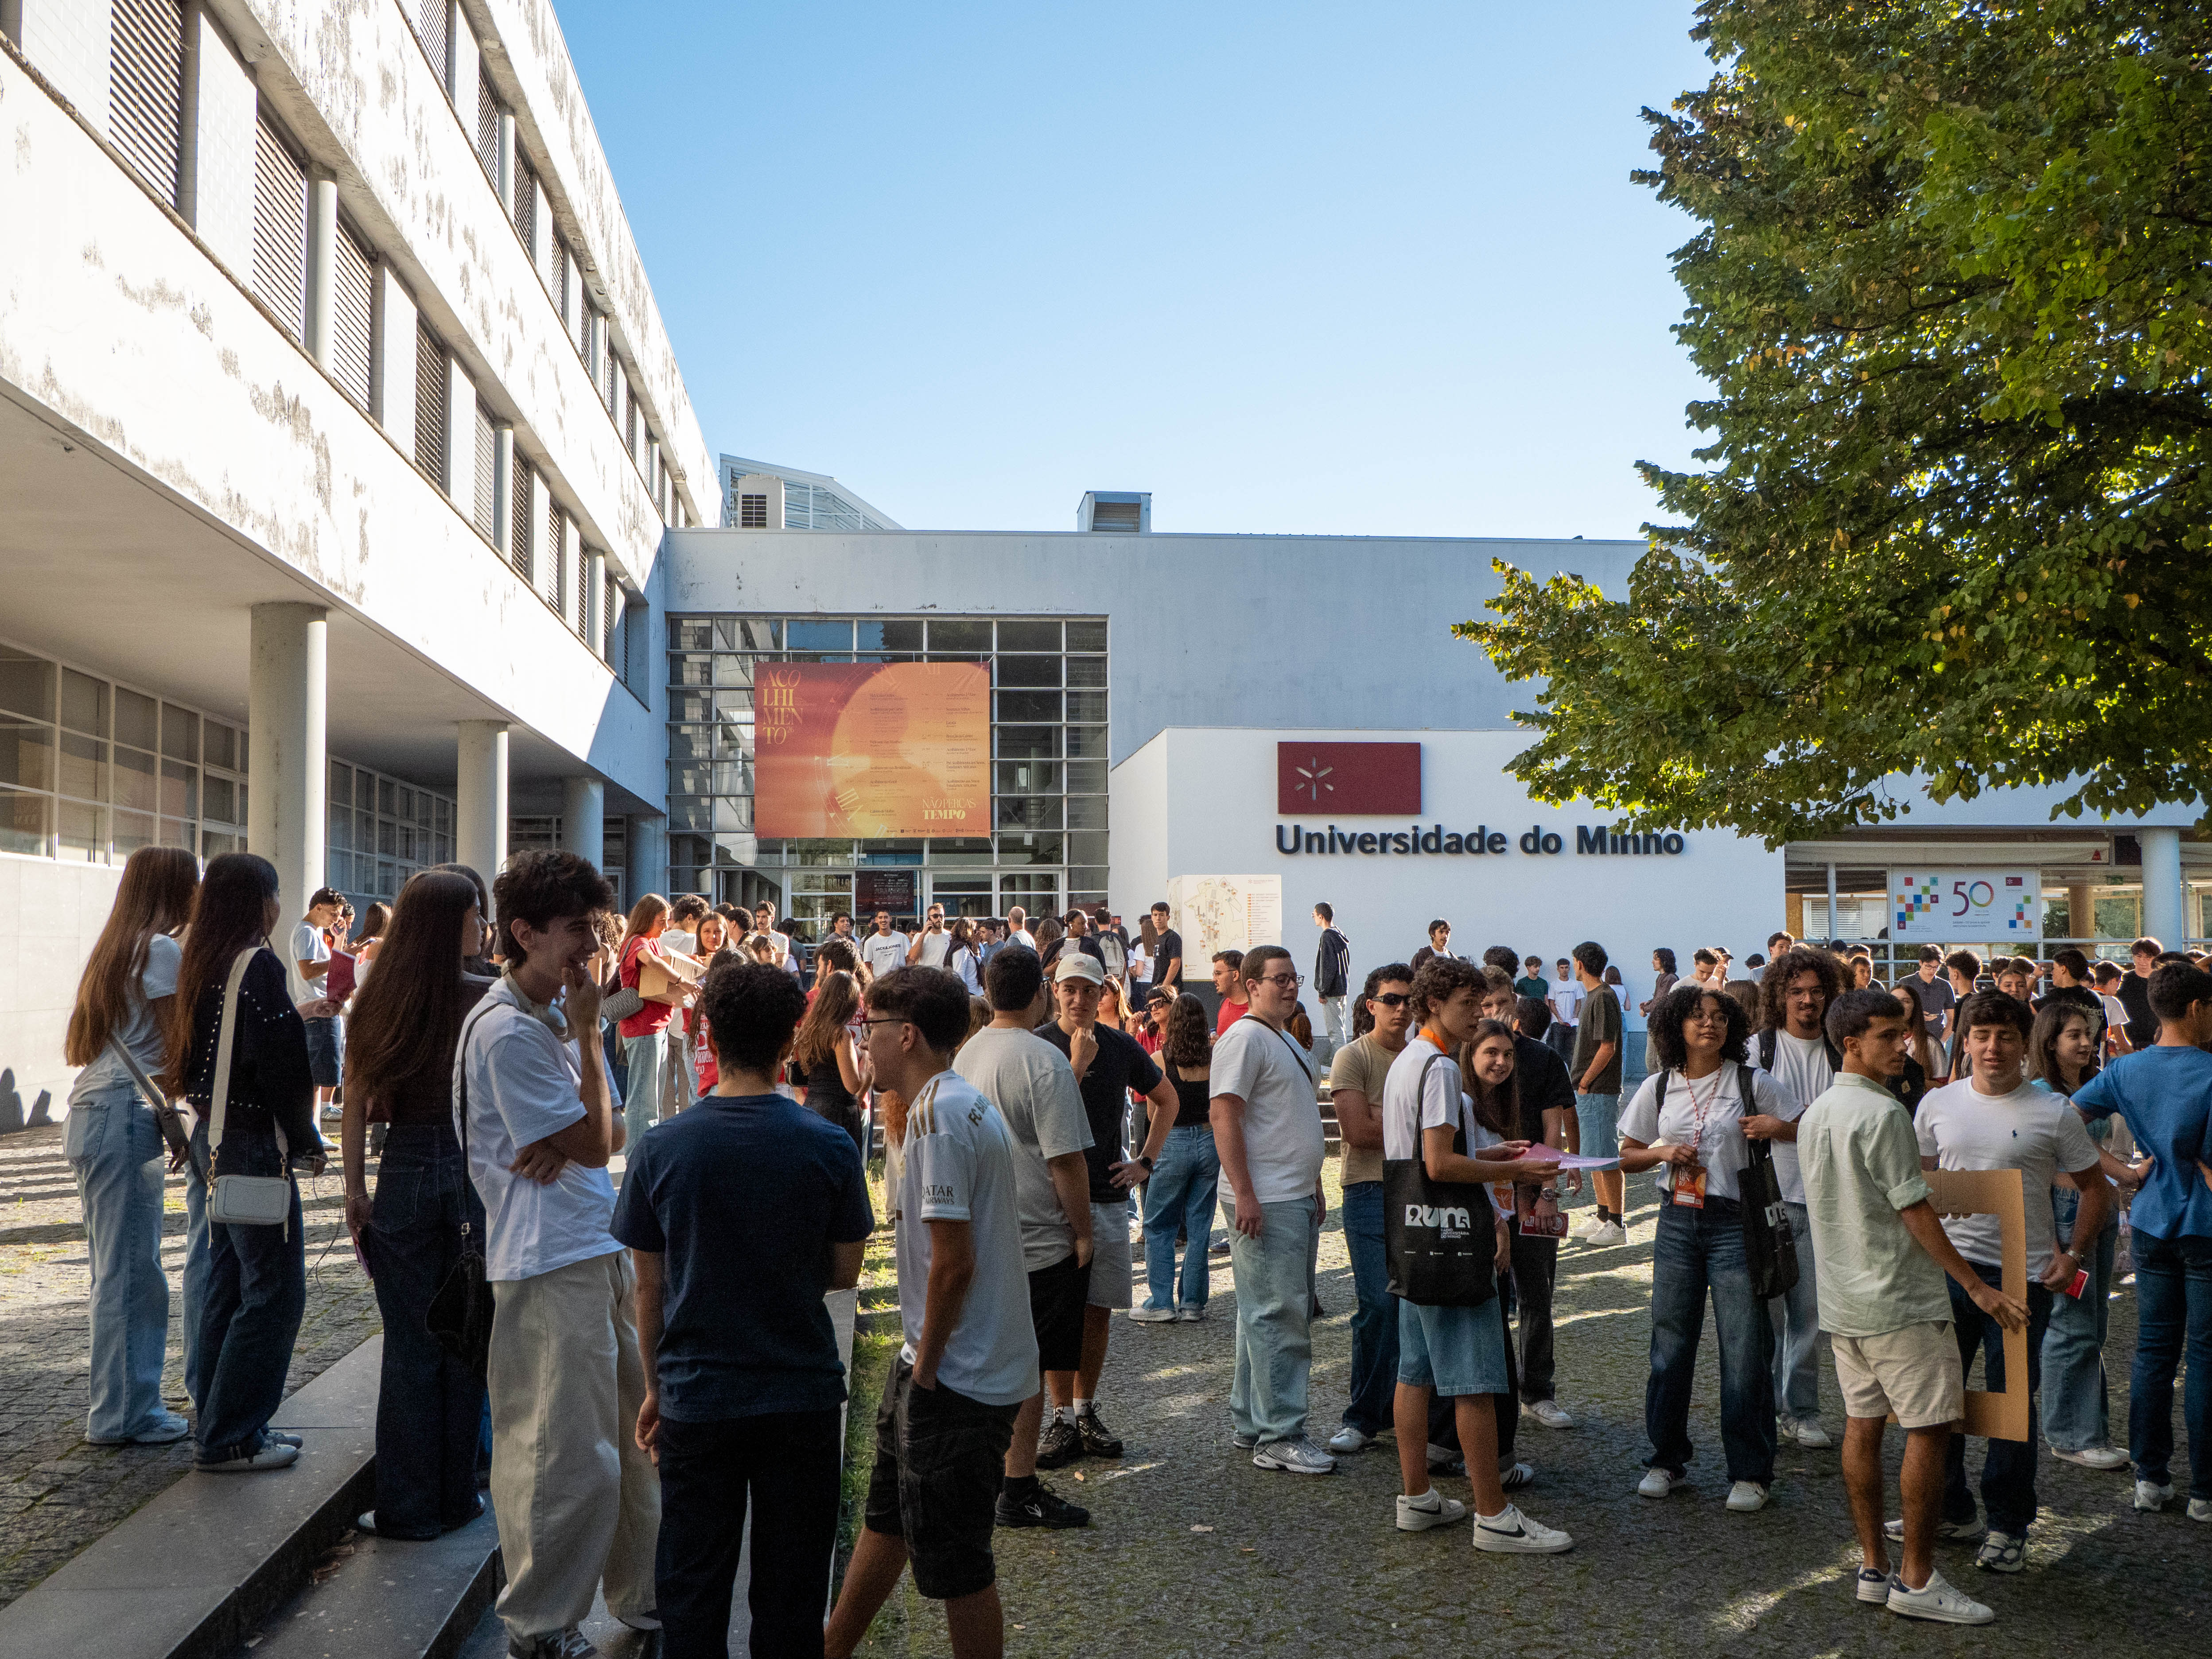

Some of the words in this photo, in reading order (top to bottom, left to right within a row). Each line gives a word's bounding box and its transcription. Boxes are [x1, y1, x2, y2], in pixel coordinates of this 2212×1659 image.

[763, 669, 801, 687] ACO
[763, 688, 794, 706] LHI
[763, 707, 803, 725] MEN
[922, 797, 942, 808] NÃO
[943, 798, 976, 809] PERCAS
[922, 809, 966, 820] TEMPO
[1276, 824, 1506, 855] Universidade
[1520, 824, 1562, 855] do
[1576, 825, 1684, 855] Minho
[1952, 881, 1994, 917] 50
